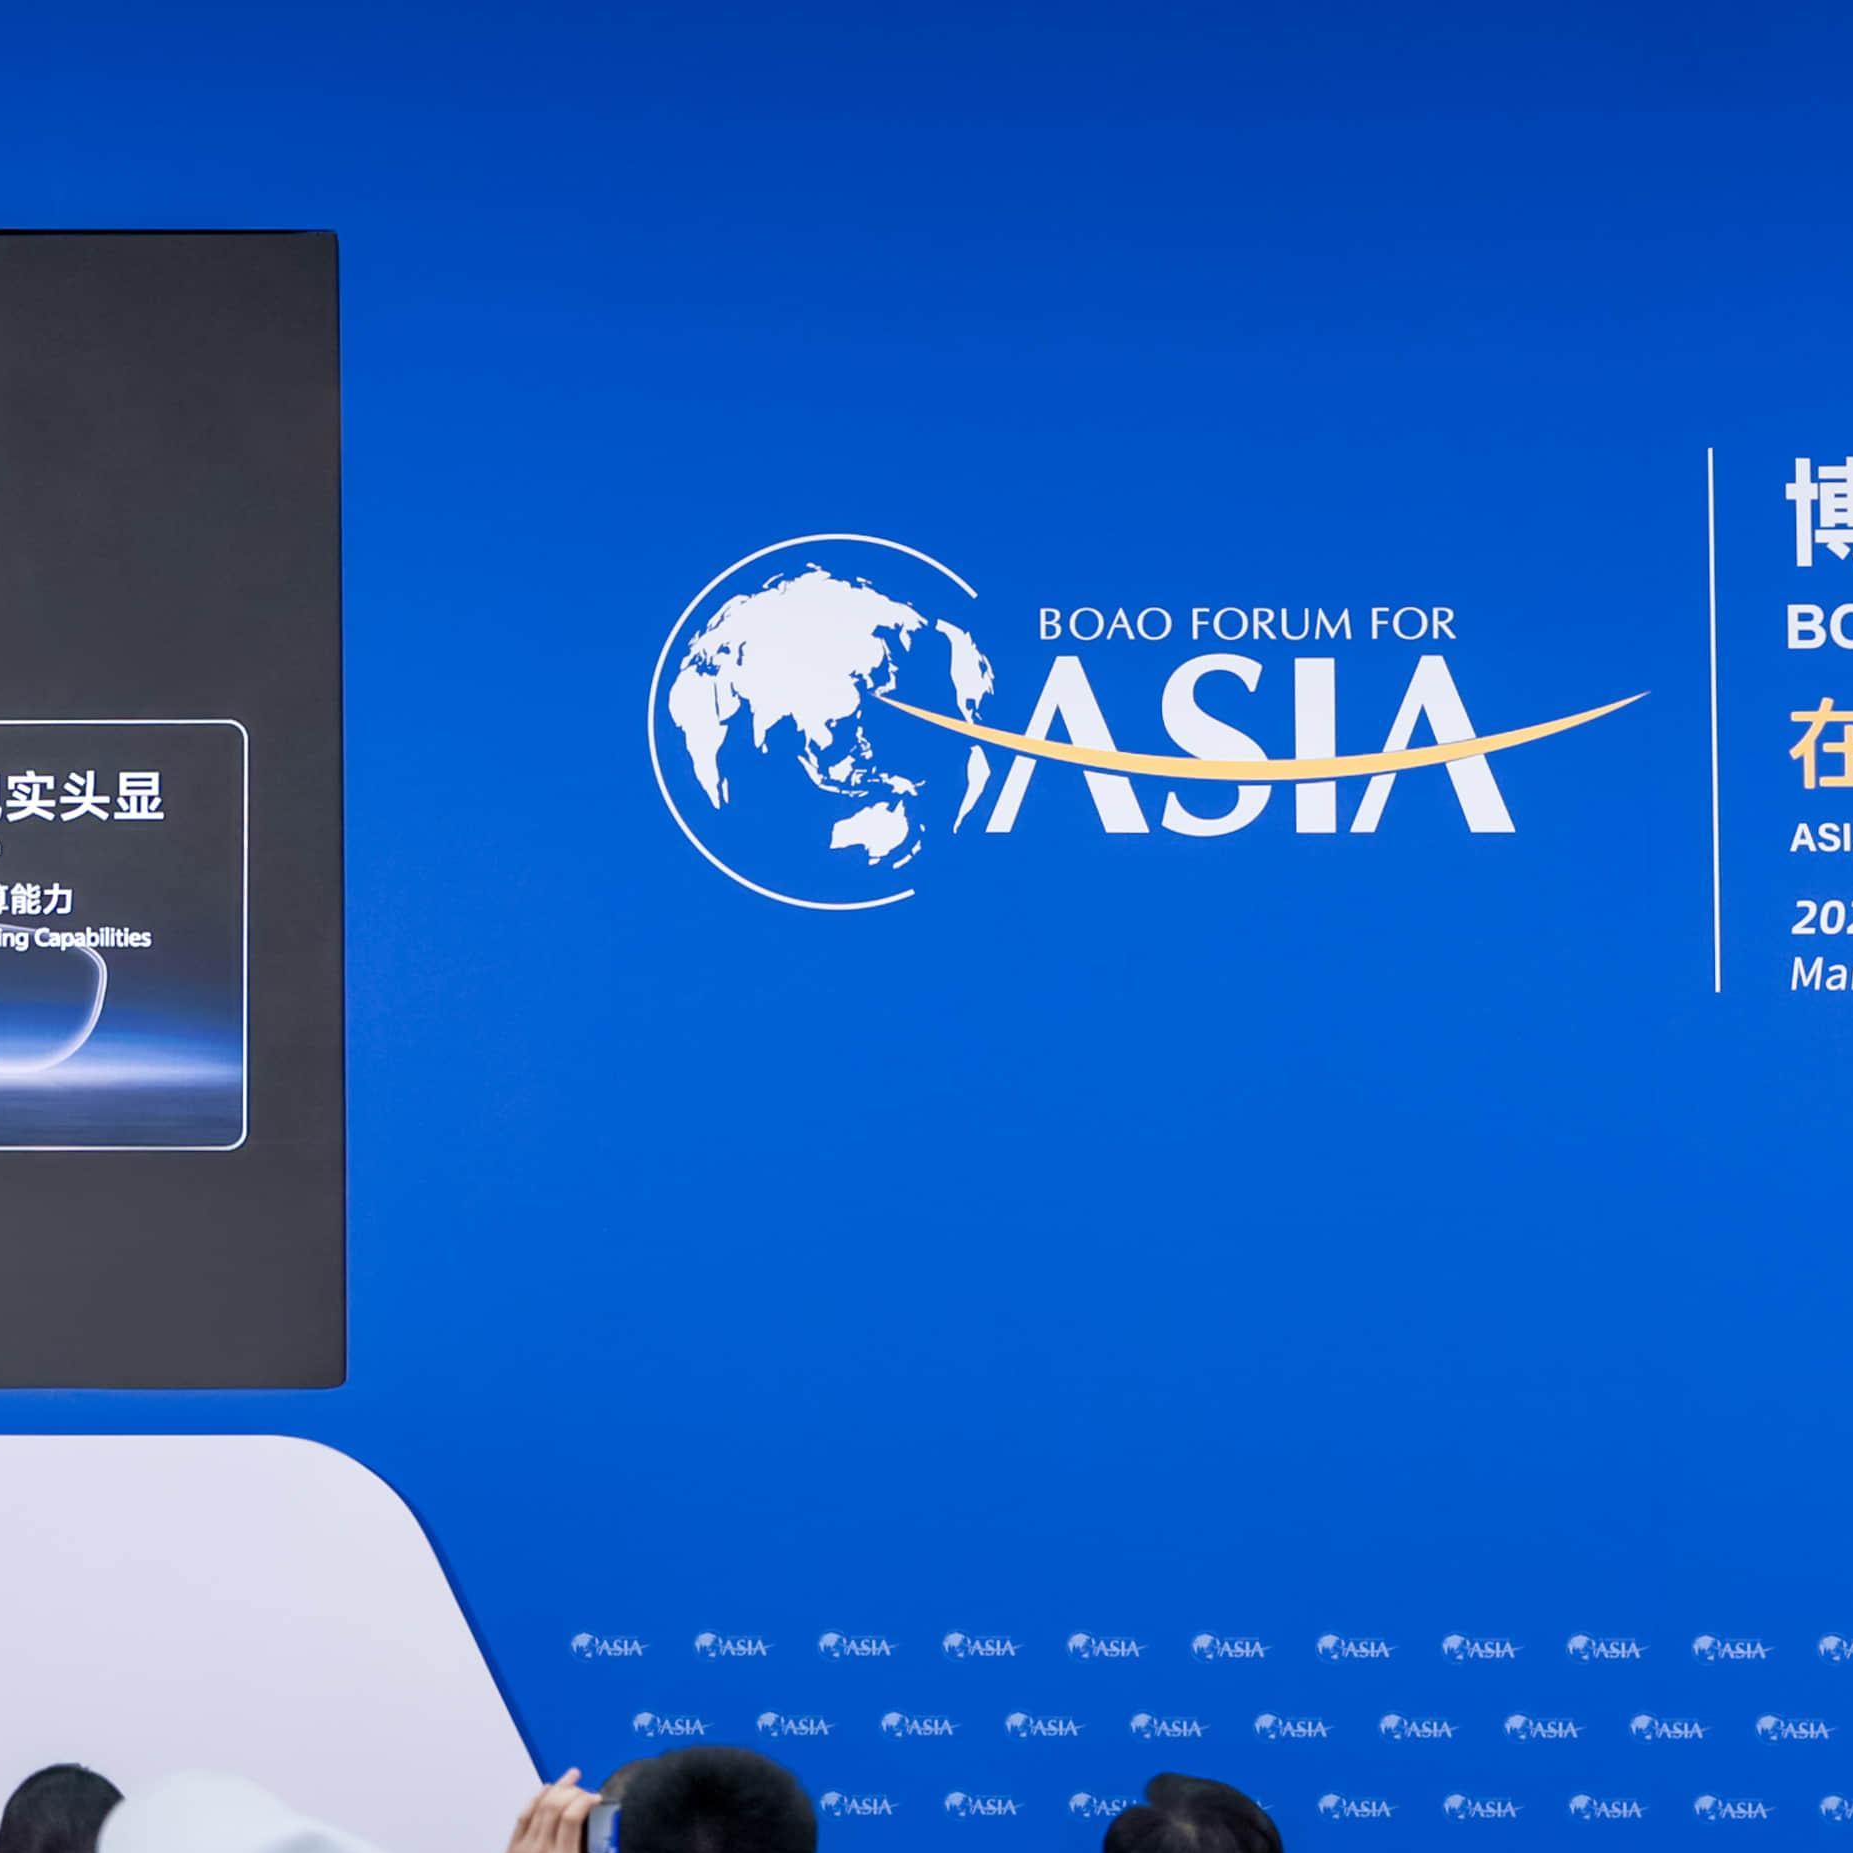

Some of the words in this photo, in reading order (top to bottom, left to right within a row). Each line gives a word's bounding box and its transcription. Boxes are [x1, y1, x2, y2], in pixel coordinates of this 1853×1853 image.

[1040, 608, 1171, 640] BOAO
[1193, 608, 1352, 640] FORUM
[1372, 607, 1456, 639] FOR
[986, 653, 1515, 836] ASIA
[34, 928, 152, 953] Capabilities
[598, 1639, 644, 1657] ASIA
[721, 1639, 767, 1657] ASIA
[846, 1639, 892, 1657] ASIA
[970, 1639, 1016, 1657] ASIA
[1095, 1640, 1141, 1658] ASIA
[1219, 1640, 1265, 1658] ASIA
[1344, 1641, 1390, 1659] ASIA
[1469, 1641, 1515, 1659] ASIA
[1595, 1641, 1641, 1659] ASIA
[1720, 1642, 1766, 1660] ASIA
[660, 1718, 706, 1736] ASIA
[784, 1718, 830, 1736] ASIA
[908, 1718, 954, 1736] ASIA
[1033, 1719, 1079, 1737] ASIA
[1157, 1720, 1203, 1738] ASIA
[1282, 1720, 1328, 1738] ASIA
[1407, 1721, 1453, 1739] ASIA
[1532, 1721, 1578, 1739] ASIA
[1658, 1721, 1704, 1739] ASIA
[1783, 1722, 1829, 1740] ASIA
[847, 1798, 893, 1816] ASIA
[971, 1798, 1017, 1816] ASIA
[1345, 1800, 1391, 1818] ASIA
[1471, 1801, 1517, 1819] ASIA
[1596, 1801, 1642, 1819] ASIA
[1722, 1802, 1768, 1820] ASIA
